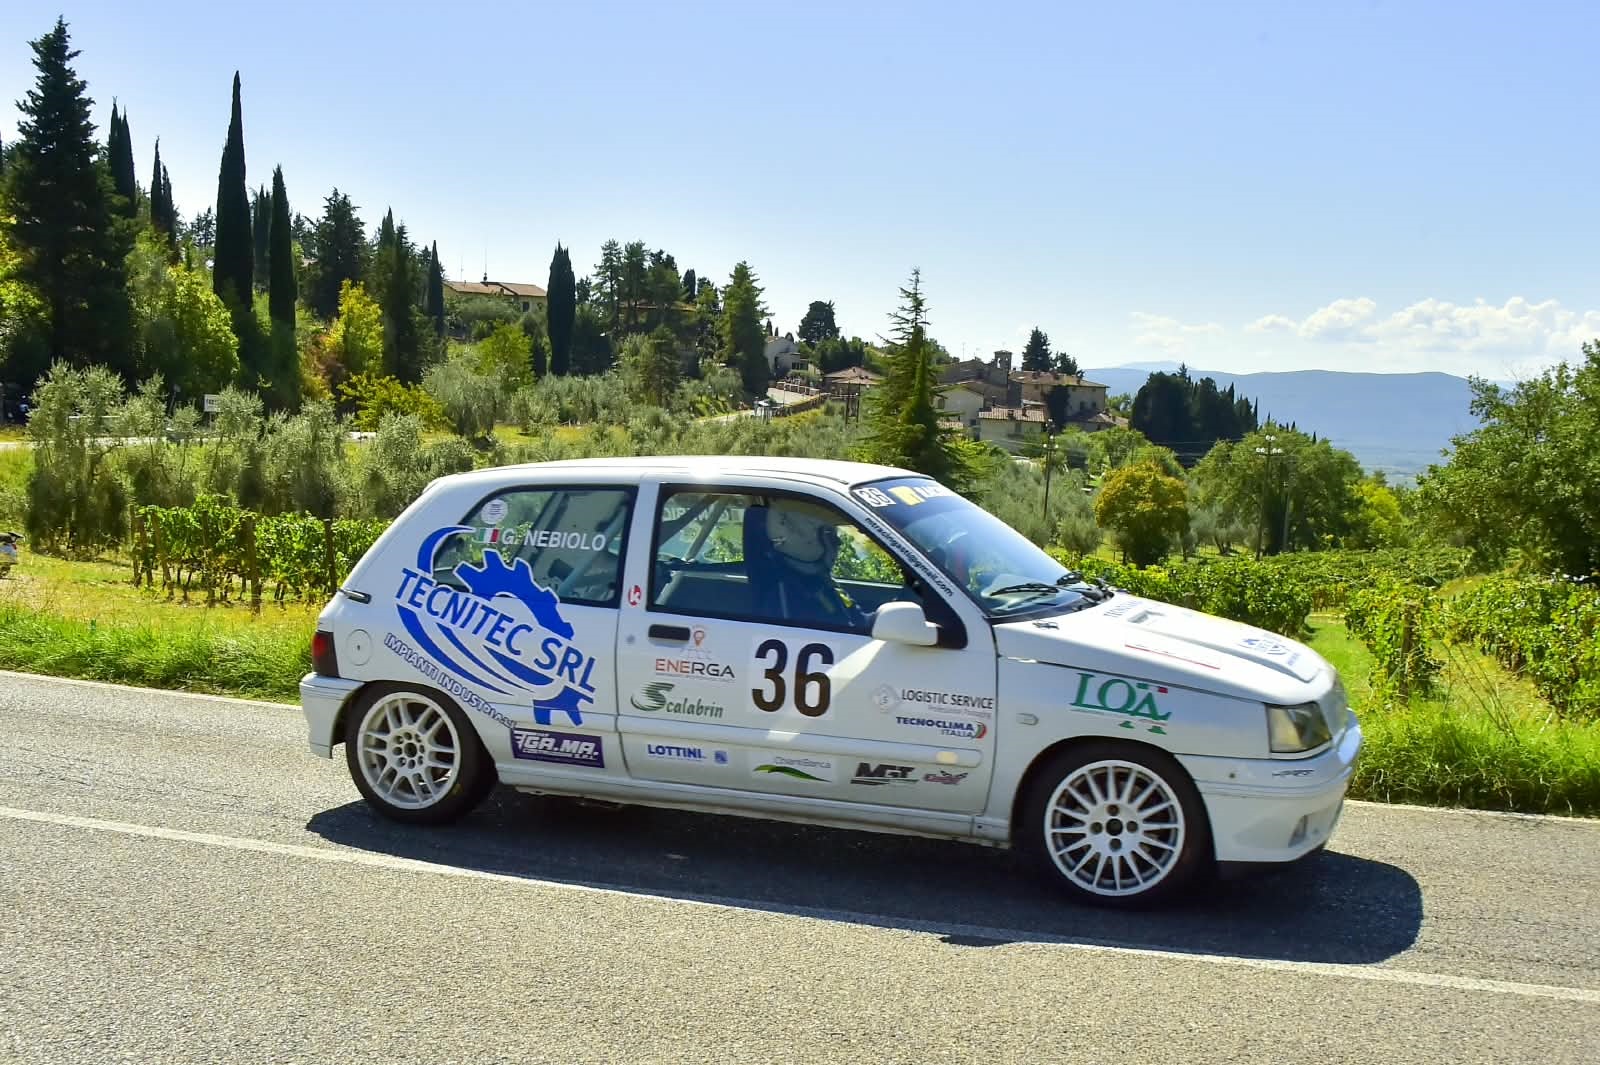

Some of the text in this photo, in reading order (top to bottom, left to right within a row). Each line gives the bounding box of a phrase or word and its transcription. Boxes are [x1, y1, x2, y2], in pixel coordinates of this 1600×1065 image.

[859, 488, 891, 506] 36
[523, 529, 606, 551] NEBIOLO
[395, 568, 597, 694] TECNITEC SRL
[384, 632, 438, 681] IMPIANTI
[655, 658, 735, 679] ENERGA
[752, 638, 834, 717] 36
[630, 681, 724, 718] Scalabrin
[901, 689, 949, 705] LOGISTIC
[950, 694, 993, 710] SERVICE
[1069, 672, 1172, 721] LOA
[895, 716, 974, 731] TECNOCLIMA
[940, 729, 975, 739] ITALIA
[648, 744, 702, 760] LOTTINI
